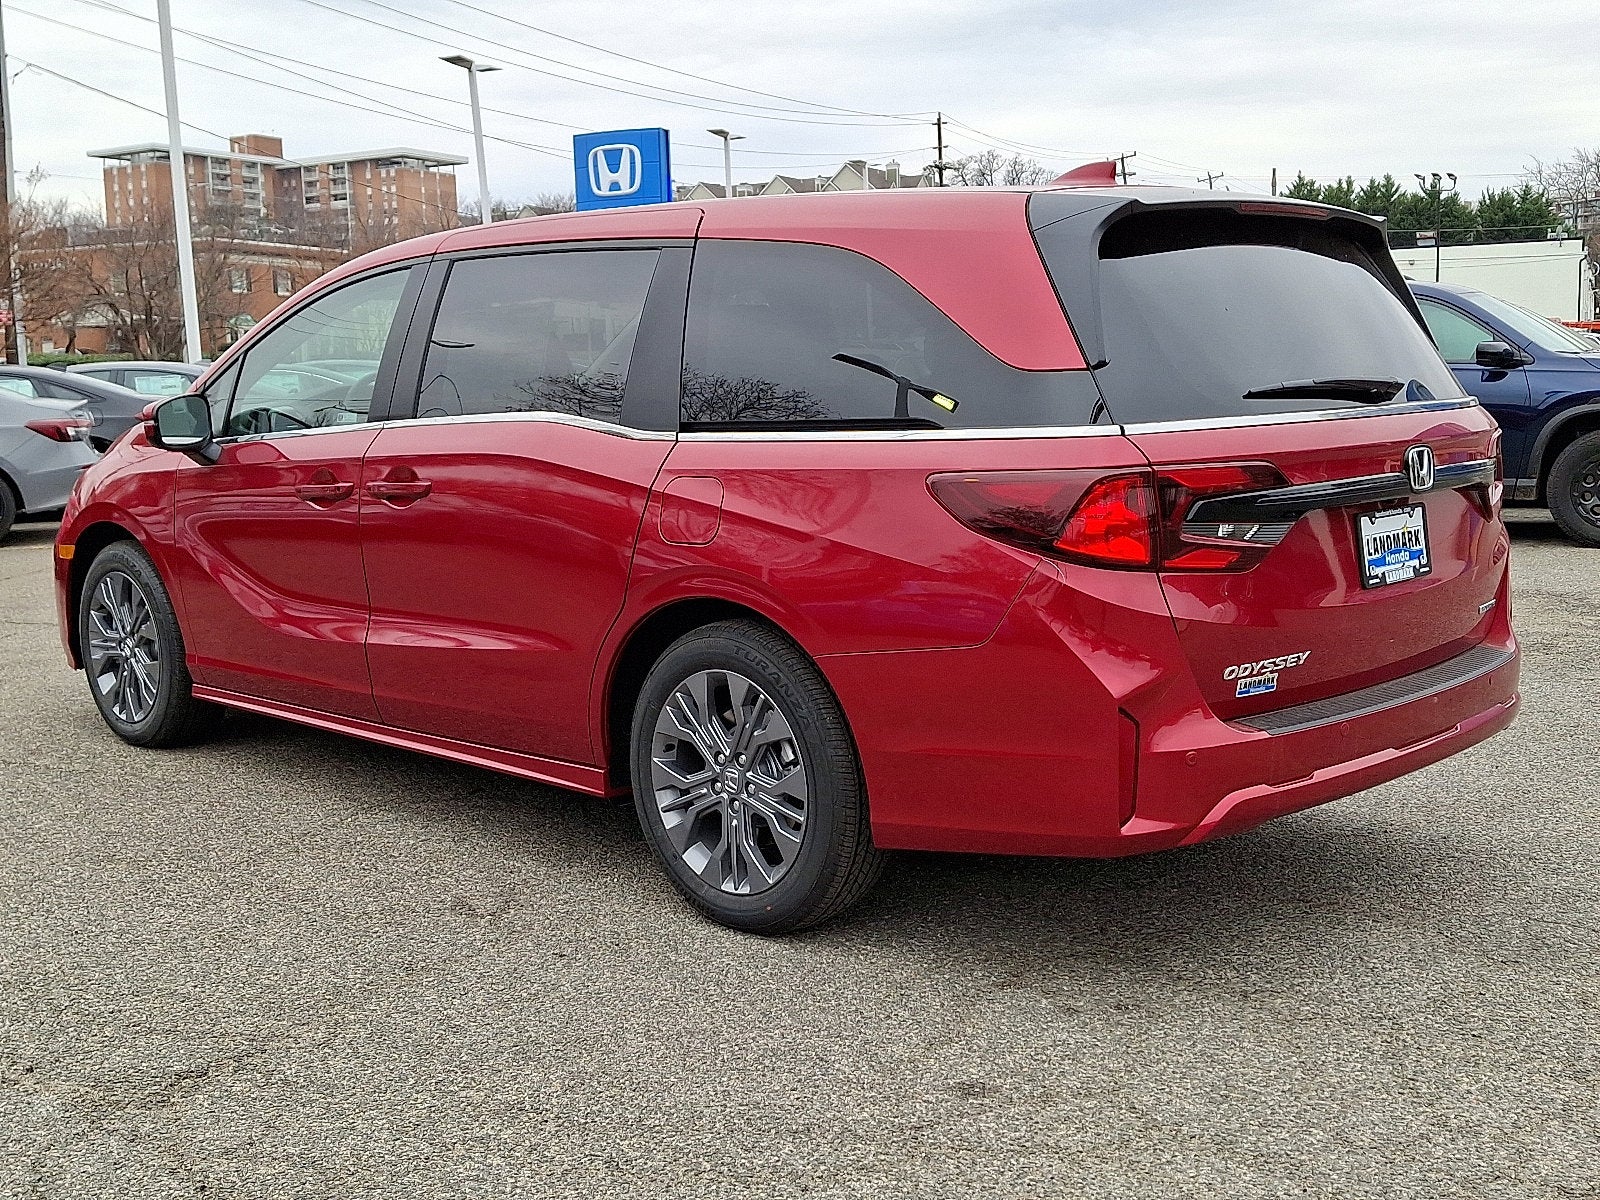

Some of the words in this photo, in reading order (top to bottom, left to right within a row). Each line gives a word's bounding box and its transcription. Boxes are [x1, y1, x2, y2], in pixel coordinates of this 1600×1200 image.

[1366, 528, 1421, 557] LANDMARK
[1385, 550, 1410, 565] Honda
[1223, 650, 1311, 680] ODYSSEY
[732, 645, 811, 729] TURANZA
[1239, 674, 1275, 690] LANDMARK
